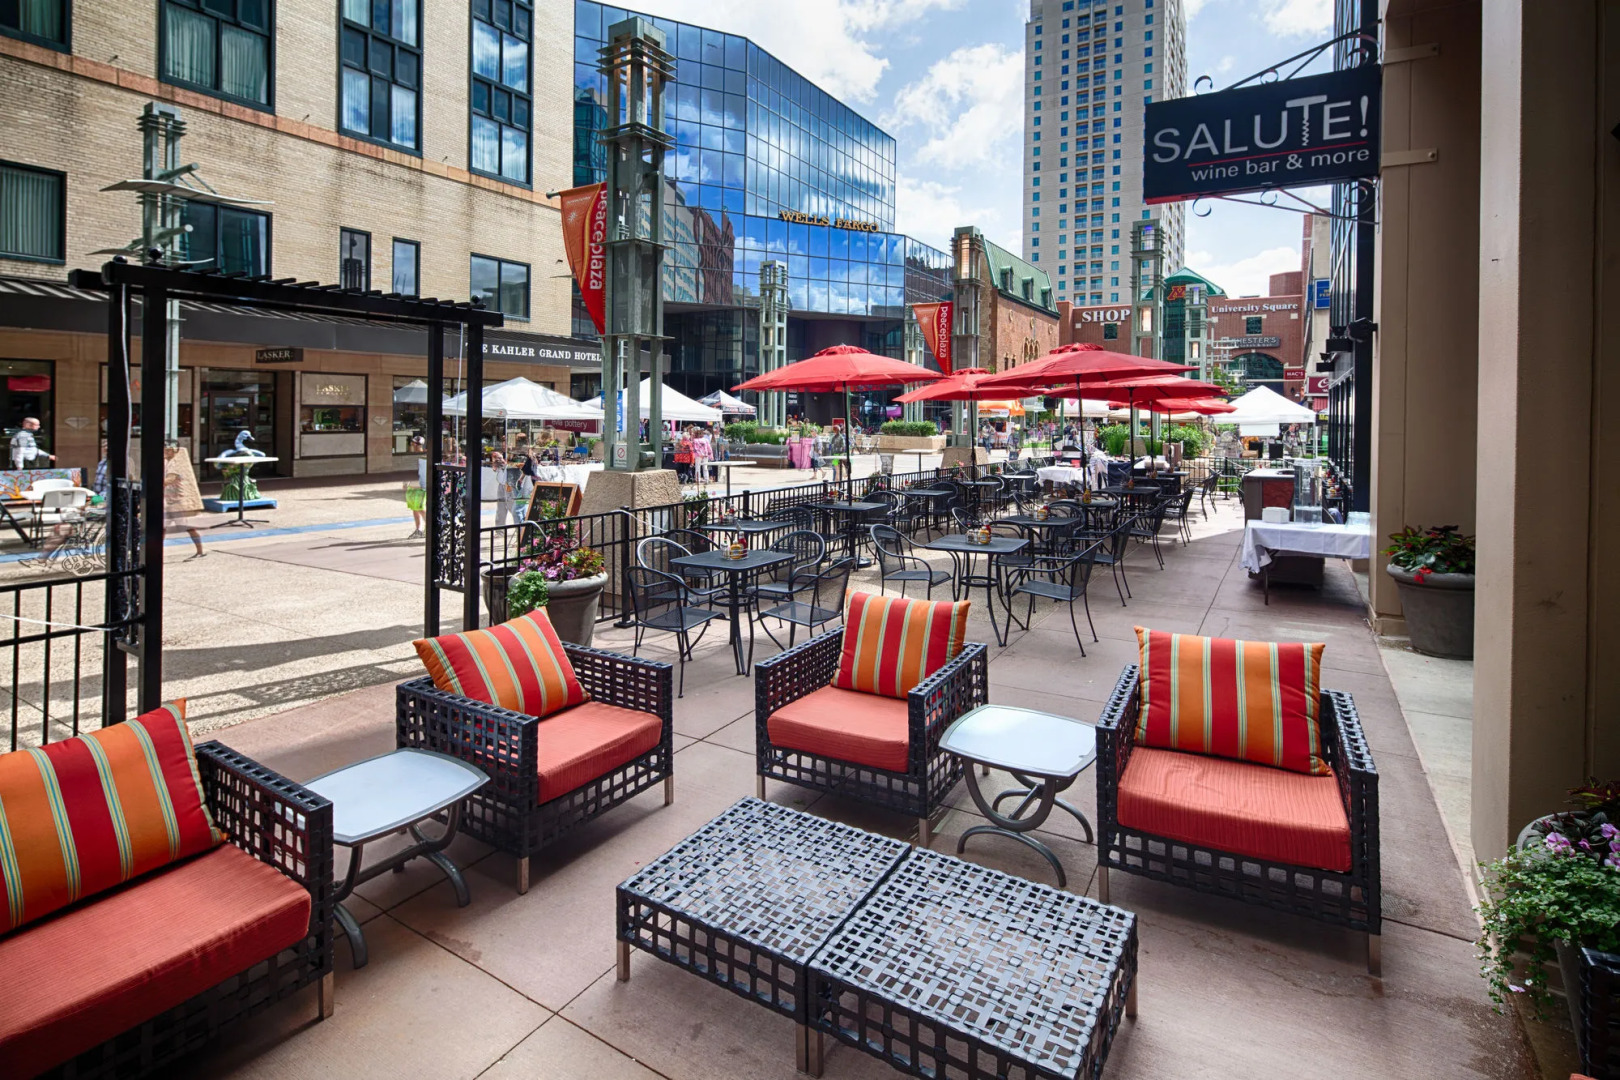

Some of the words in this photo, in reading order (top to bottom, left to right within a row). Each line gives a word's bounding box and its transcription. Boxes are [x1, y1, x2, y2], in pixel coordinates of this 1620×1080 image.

[1152, 94, 1369, 163] SALUTE!
[1191, 164, 1239, 182] wine
[1246, 158, 1280, 175] bar
[1285, 153, 1303, 170] &
[1310, 148, 1370, 167] more
[780, 210, 830, 226] WELLS
[835, 217, 879, 232] FARGO
[1081, 309, 1131, 322] SHOP
[1211, 303, 1260, 313] University
[1262, 303, 1298, 312] Square
[938, 306, 949, 358] peaceplaza
[491, 344, 535, 357] KAHLER
[539, 348, 571, 360] GRAND
[574, 351, 602, 362] HOTEL
[564, 419, 588, 430] pottery
